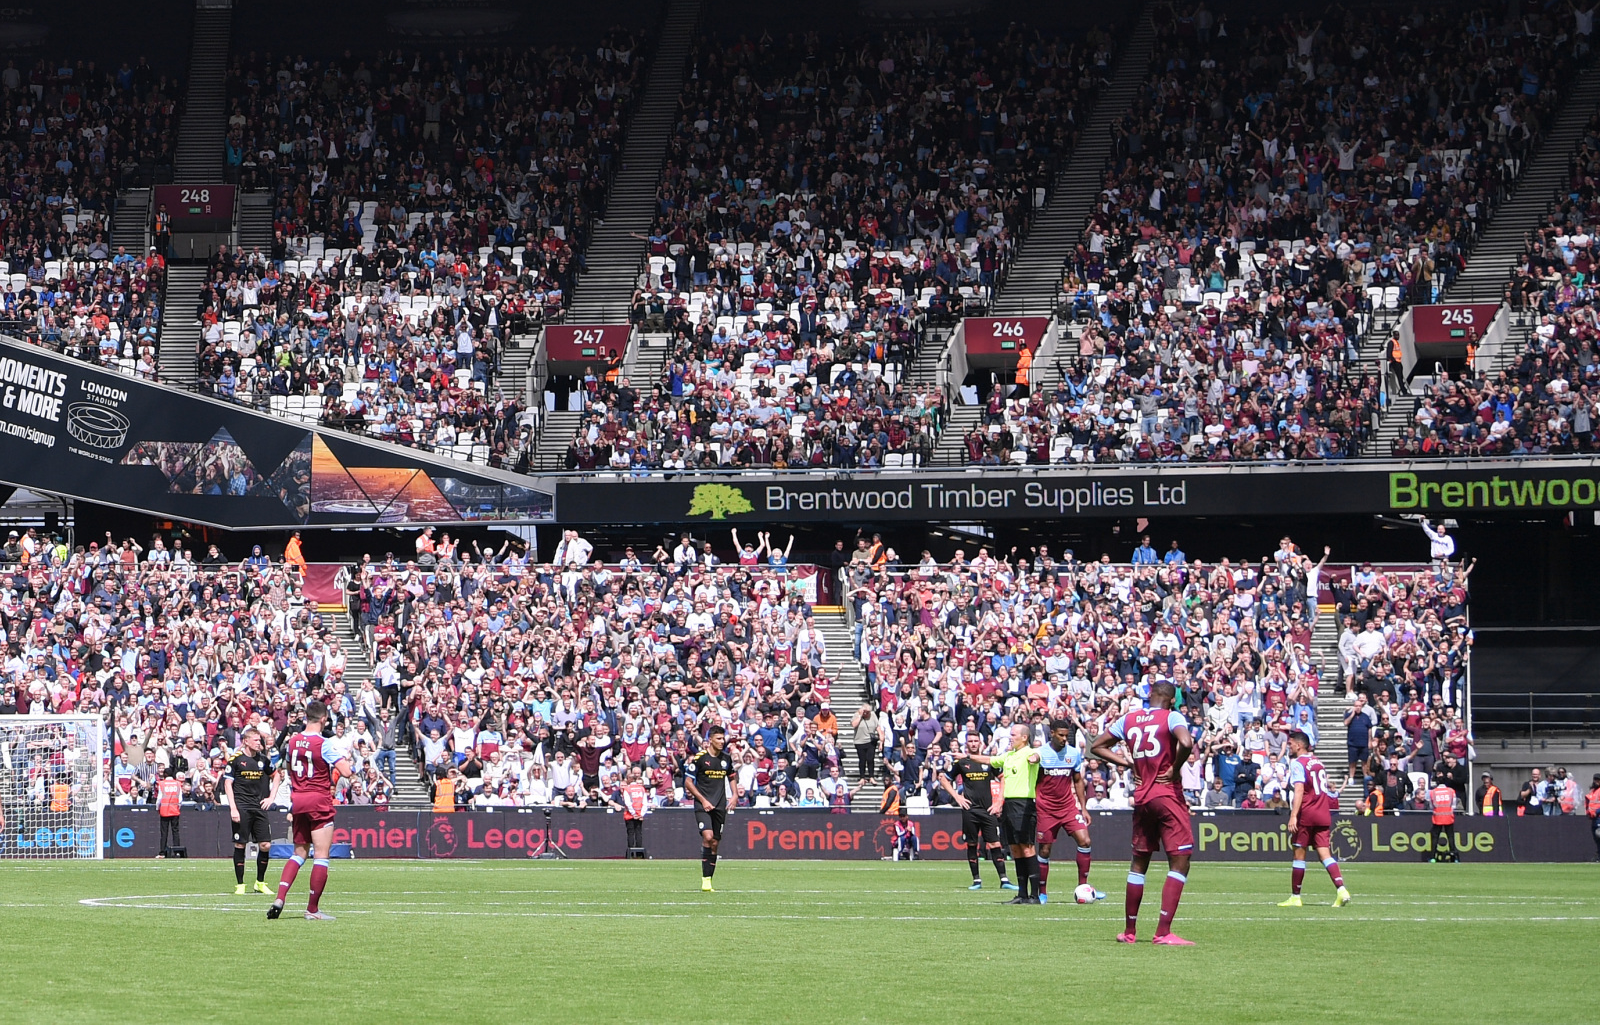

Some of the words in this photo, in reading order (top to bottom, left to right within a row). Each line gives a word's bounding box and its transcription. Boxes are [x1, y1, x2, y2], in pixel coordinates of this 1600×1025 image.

[180, 189, 210, 203] 248
[1441, 308, 1474, 325] 245
[573, 329, 604, 344] 247
[992, 321, 1024, 337] 246
[80, 379, 128, 403] LONDON
[85, 393, 119, 408] STADIUM
[3, 385, 16, 409] &
[16, 388, 64, 423] MORE
[68, 445, 79, 455] THE
[78, 448, 99, 460] WORLD'S
[98, 454, 114, 464] STAGE
[766, 484, 913, 510] Brentwood
[921, 482, 1017, 509] Timber
[1024, 481, 1135, 514] Supplies
[1143, 480, 1187, 506] Ltd
[1388, 471, 1600, 509] Brentwoo
[295, 740, 311, 749] RICE
[1127, 724, 1161, 759] 23
[291, 749, 314, 778] 41
[1043, 767, 1072, 777] betway
[1309, 769, 1328, 796] 18
[332, 820, 418, 848] emier
[467, 819, 584, 857] League
[747, 820, 864, 850] Premier
